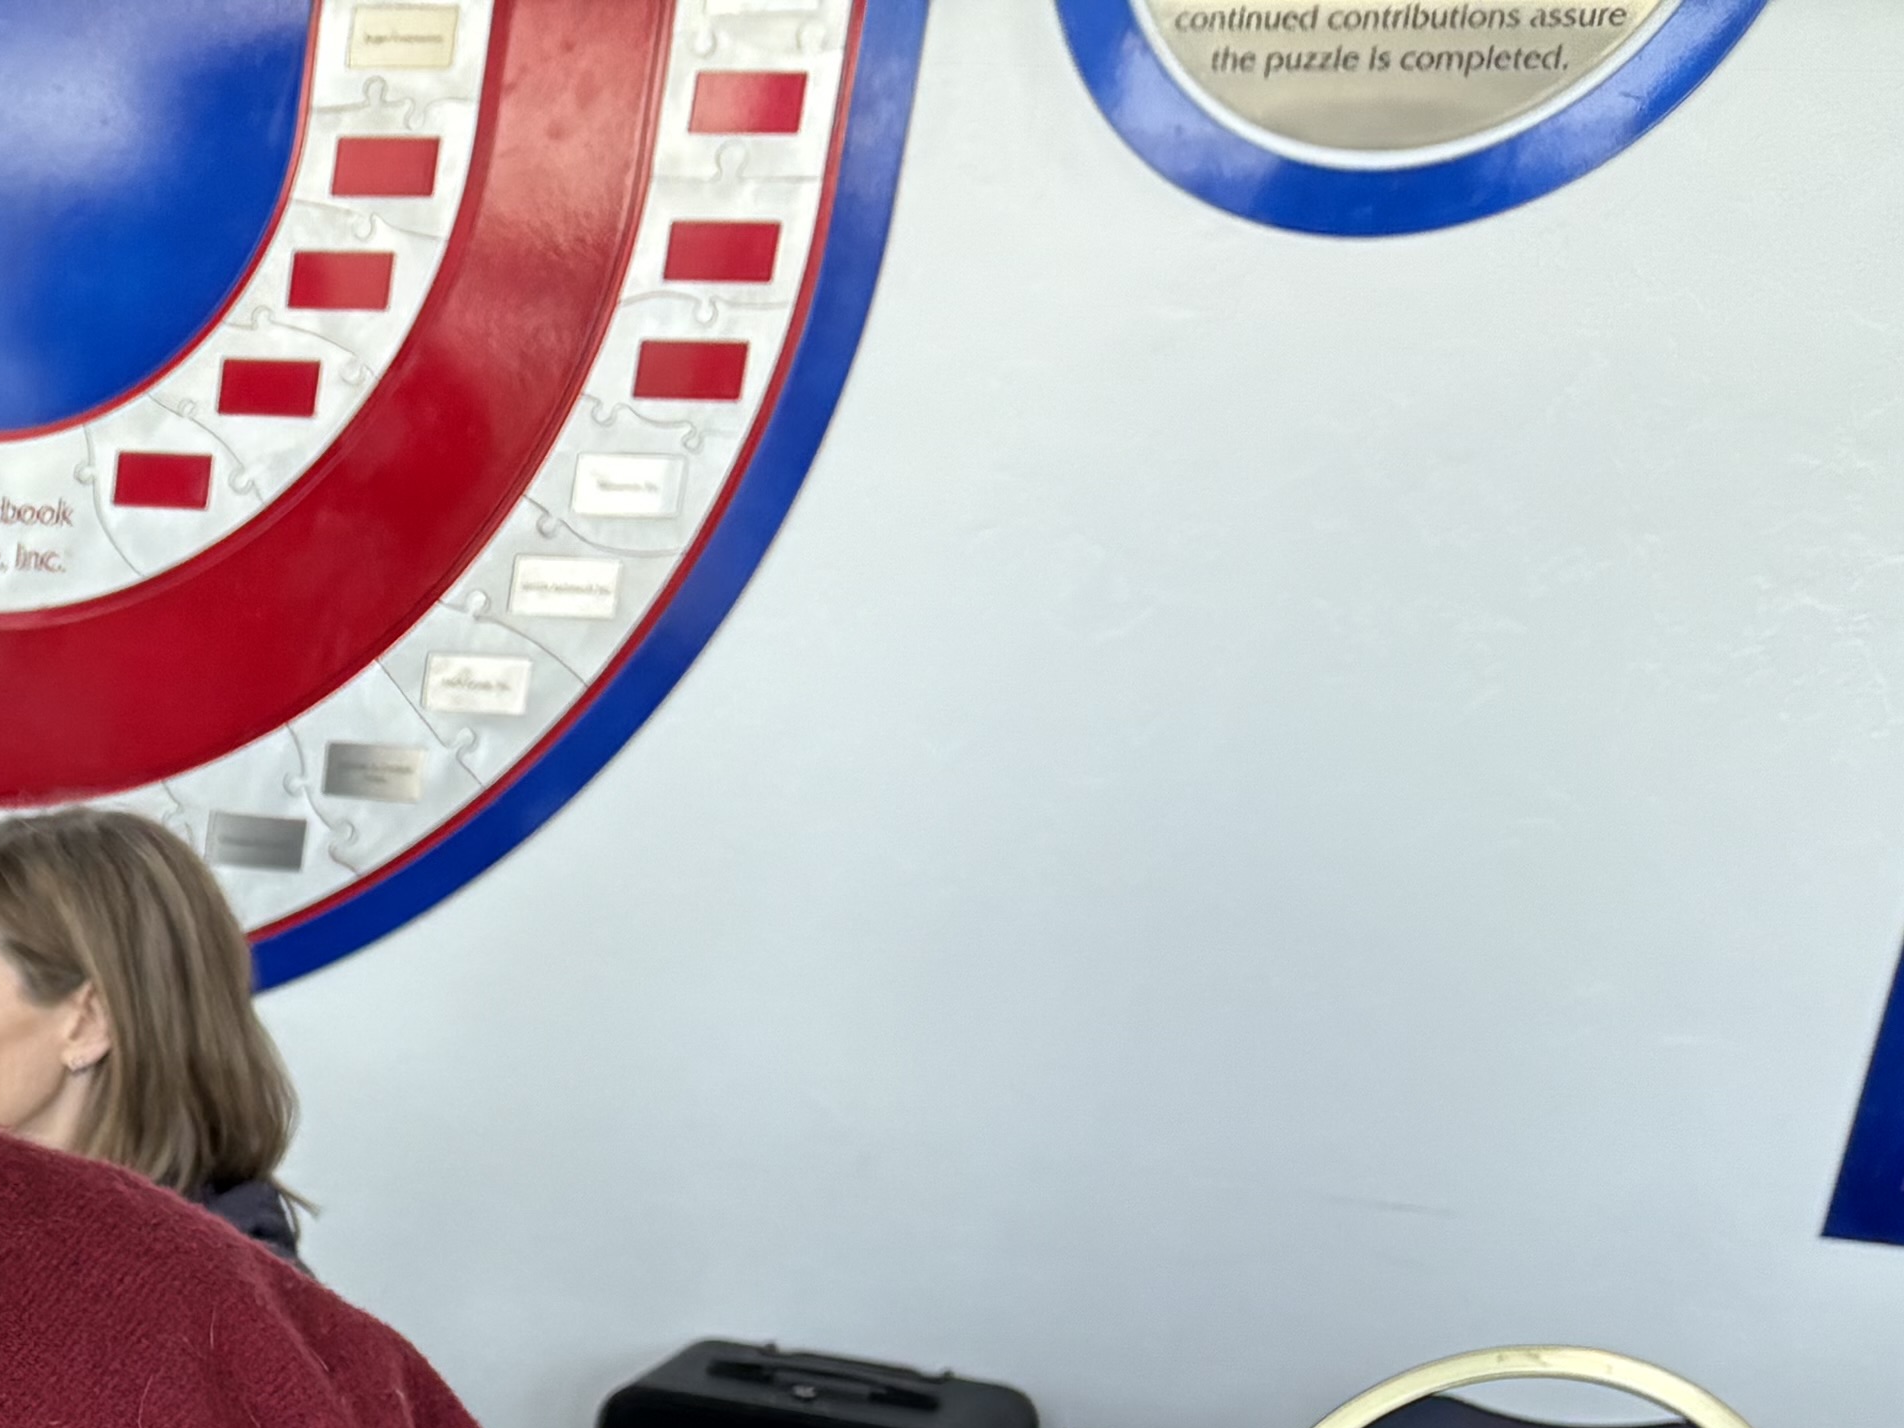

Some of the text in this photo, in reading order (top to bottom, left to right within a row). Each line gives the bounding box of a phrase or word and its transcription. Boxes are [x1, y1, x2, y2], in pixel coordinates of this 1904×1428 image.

[1175, 2, 1628, 31] continued contributions assure
[1212, 44, 1569, 78] the puzzle is completed.
[16, 542, 67, 573] Inc.
